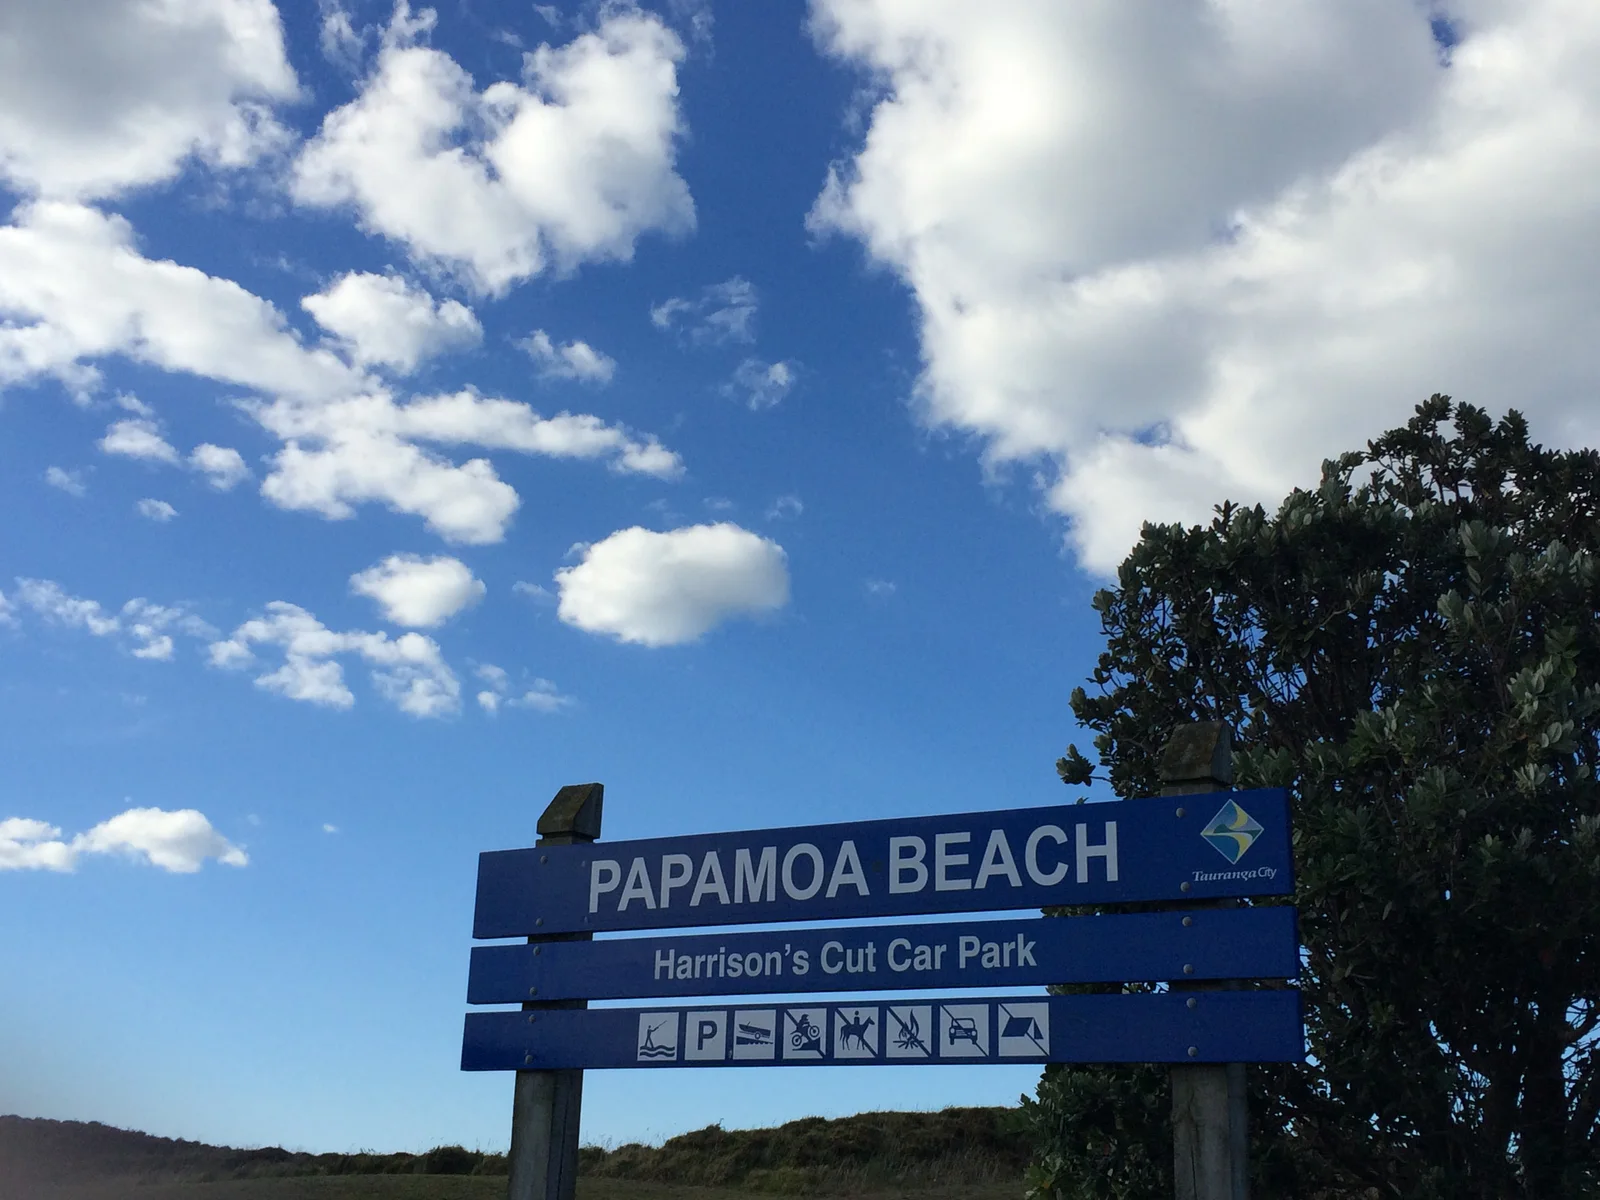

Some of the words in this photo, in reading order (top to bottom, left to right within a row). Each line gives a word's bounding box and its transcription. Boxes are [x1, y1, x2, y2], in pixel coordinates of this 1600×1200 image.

[589, 840, 870, 913] PAPAMOA
[889, 821, 1119, 894] BEACH
[654, 943, 810, 980] Harrison's
[820, 940, 877, 974] Cut
[887, 938, 947, 972] Car
[958, 934, 1037, 969] Park
[697, 1020, 718, 1051] P
